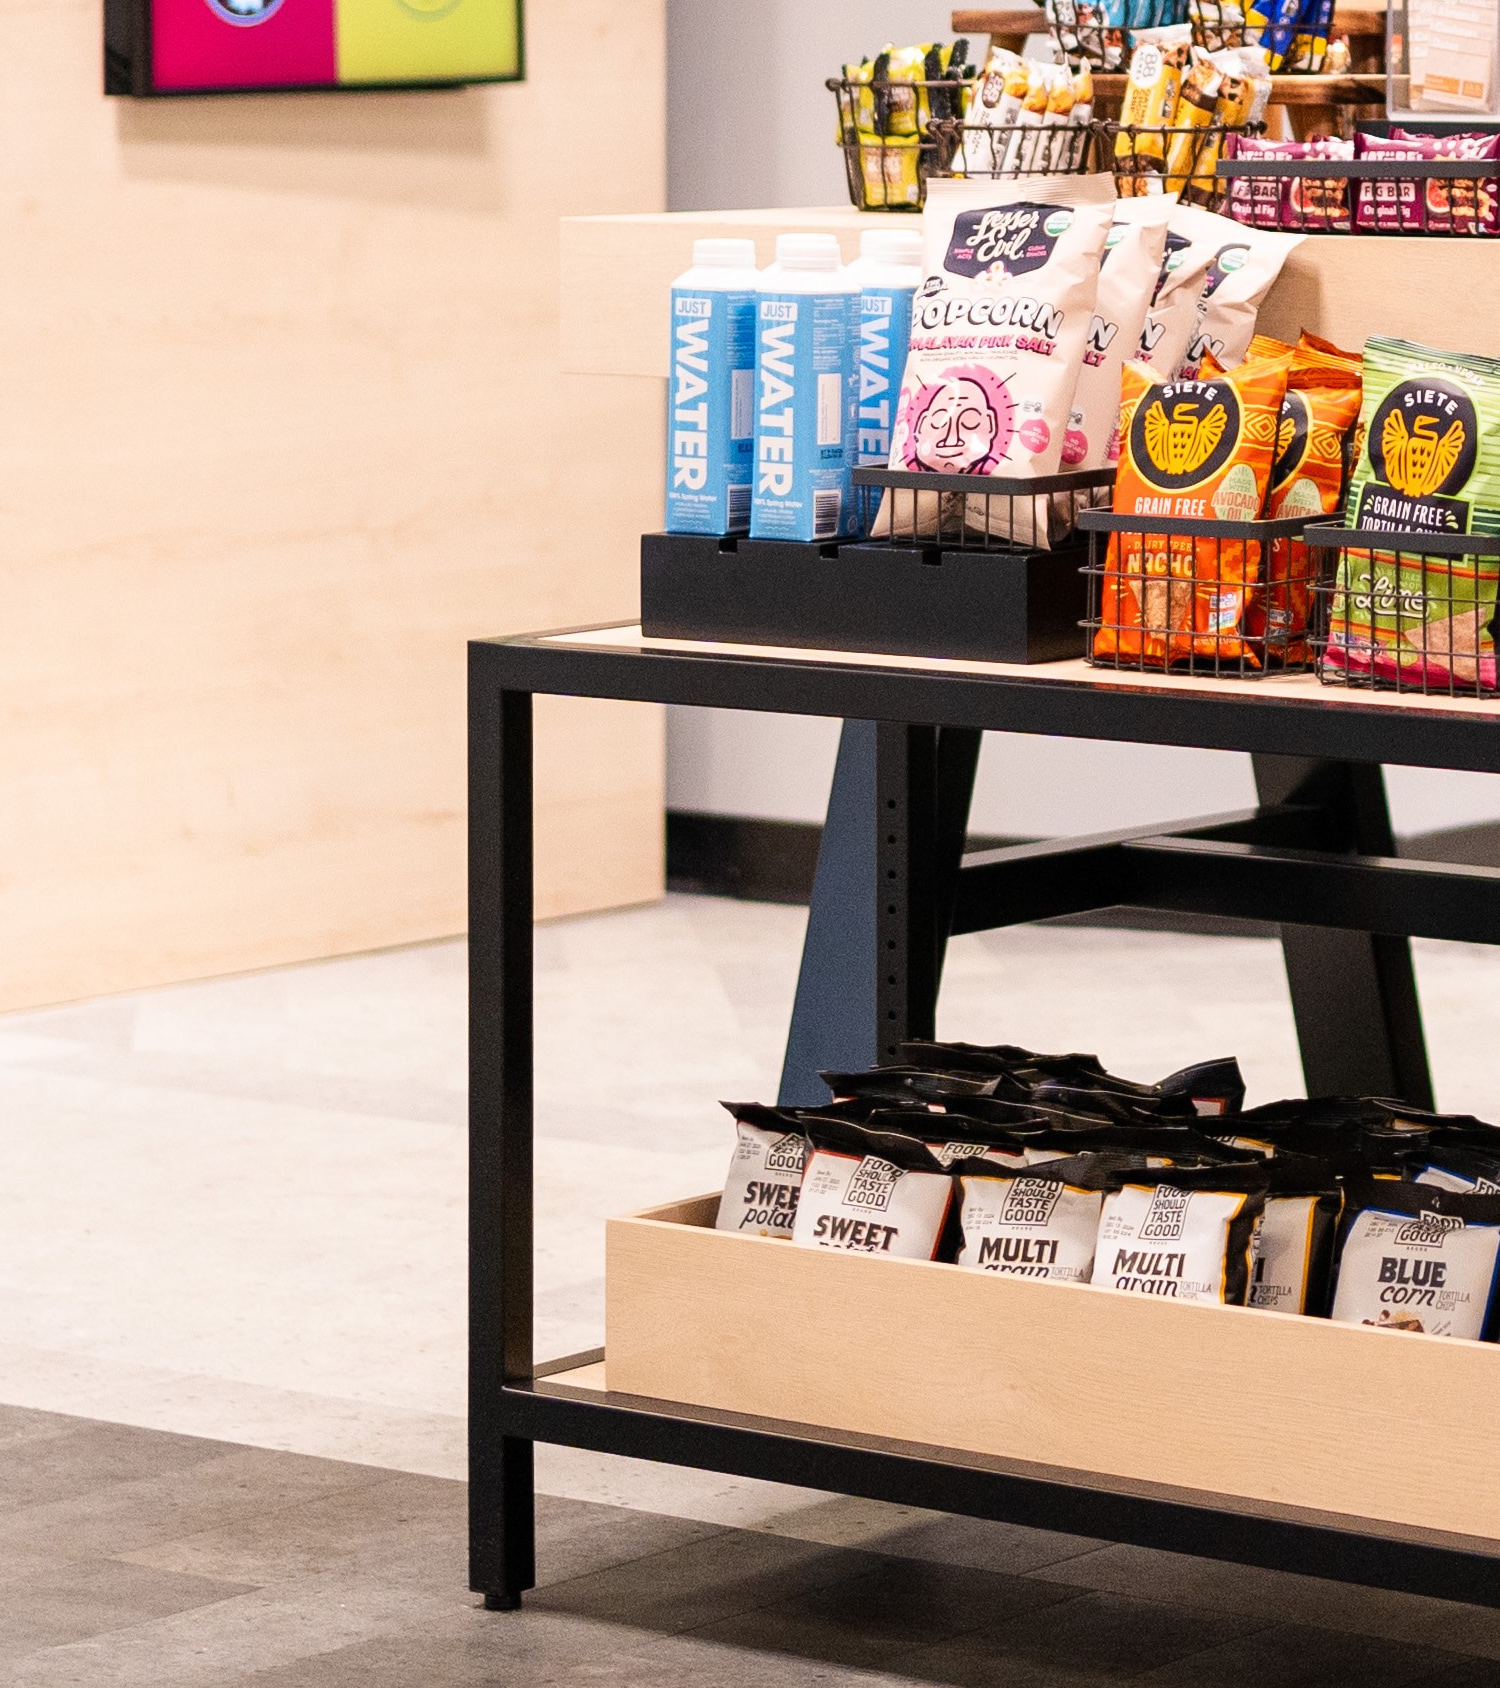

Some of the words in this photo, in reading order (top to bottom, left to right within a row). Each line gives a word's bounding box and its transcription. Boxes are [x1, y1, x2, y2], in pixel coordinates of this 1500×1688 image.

[678, 300, 708, 314] JUST
[763, 305, 793, 319] JUST
[909, 335, 977, 351] MALAYAN
[979, 334, 1014, 349] PINK
[1015, 334, 1057, 356] SALT
[1163, 381, 1218, 402] SIETE
[674, 319, 710, 492] WATER
[758, 323, 796, 498] WATER
[1404, 389, 1459, 415] SIETE
[1134, 496, 1171, 514] GRAIN
[1174, 498, 1207, 517] FREE
[1213, 492, 1260, 509] AVOCADO
[1373, 495, 1411, 518] GRAIN
[1413, 503, 1443, 526] FREE
[1133, 539, 1165, 552] DIRY
[945, 1142, 986, 1156] FOOD
[857, 1168, 899, 1184] SHOULD
[861, 1157, 902, 1179] FOOD
[853, 1179, 891, 1194] TASTE
[1012, 1185, 1057, 1201] SHOULD
[1155, 1185, 1191, 1200] FOOD
[1008, 1196, 1051, 1212] TASTE
[1153, 1197, 1187, 1211] SHOULD
[1150, 1210, 1183, 1224] TASTE
[812, 1214, 899, 1251] SWEET
[977, 1236, 1060, 1265] MULTI
[1112, 1248, 1188, 1278] MULTI
[1376, 1256, 1448, 1288] BLUE
[1115, 1276, 1181, 1299] grain
[1258, 1284, 1293, 1298] TORTILLA
[1379, 1284, 1437, 1308] corn
[1438, 1290, 1472, 1304] TORTILLA
[1256, 1293, 1280, 1306] CHIPS
[1435, 1298, 1457, 1312] CHIPS
